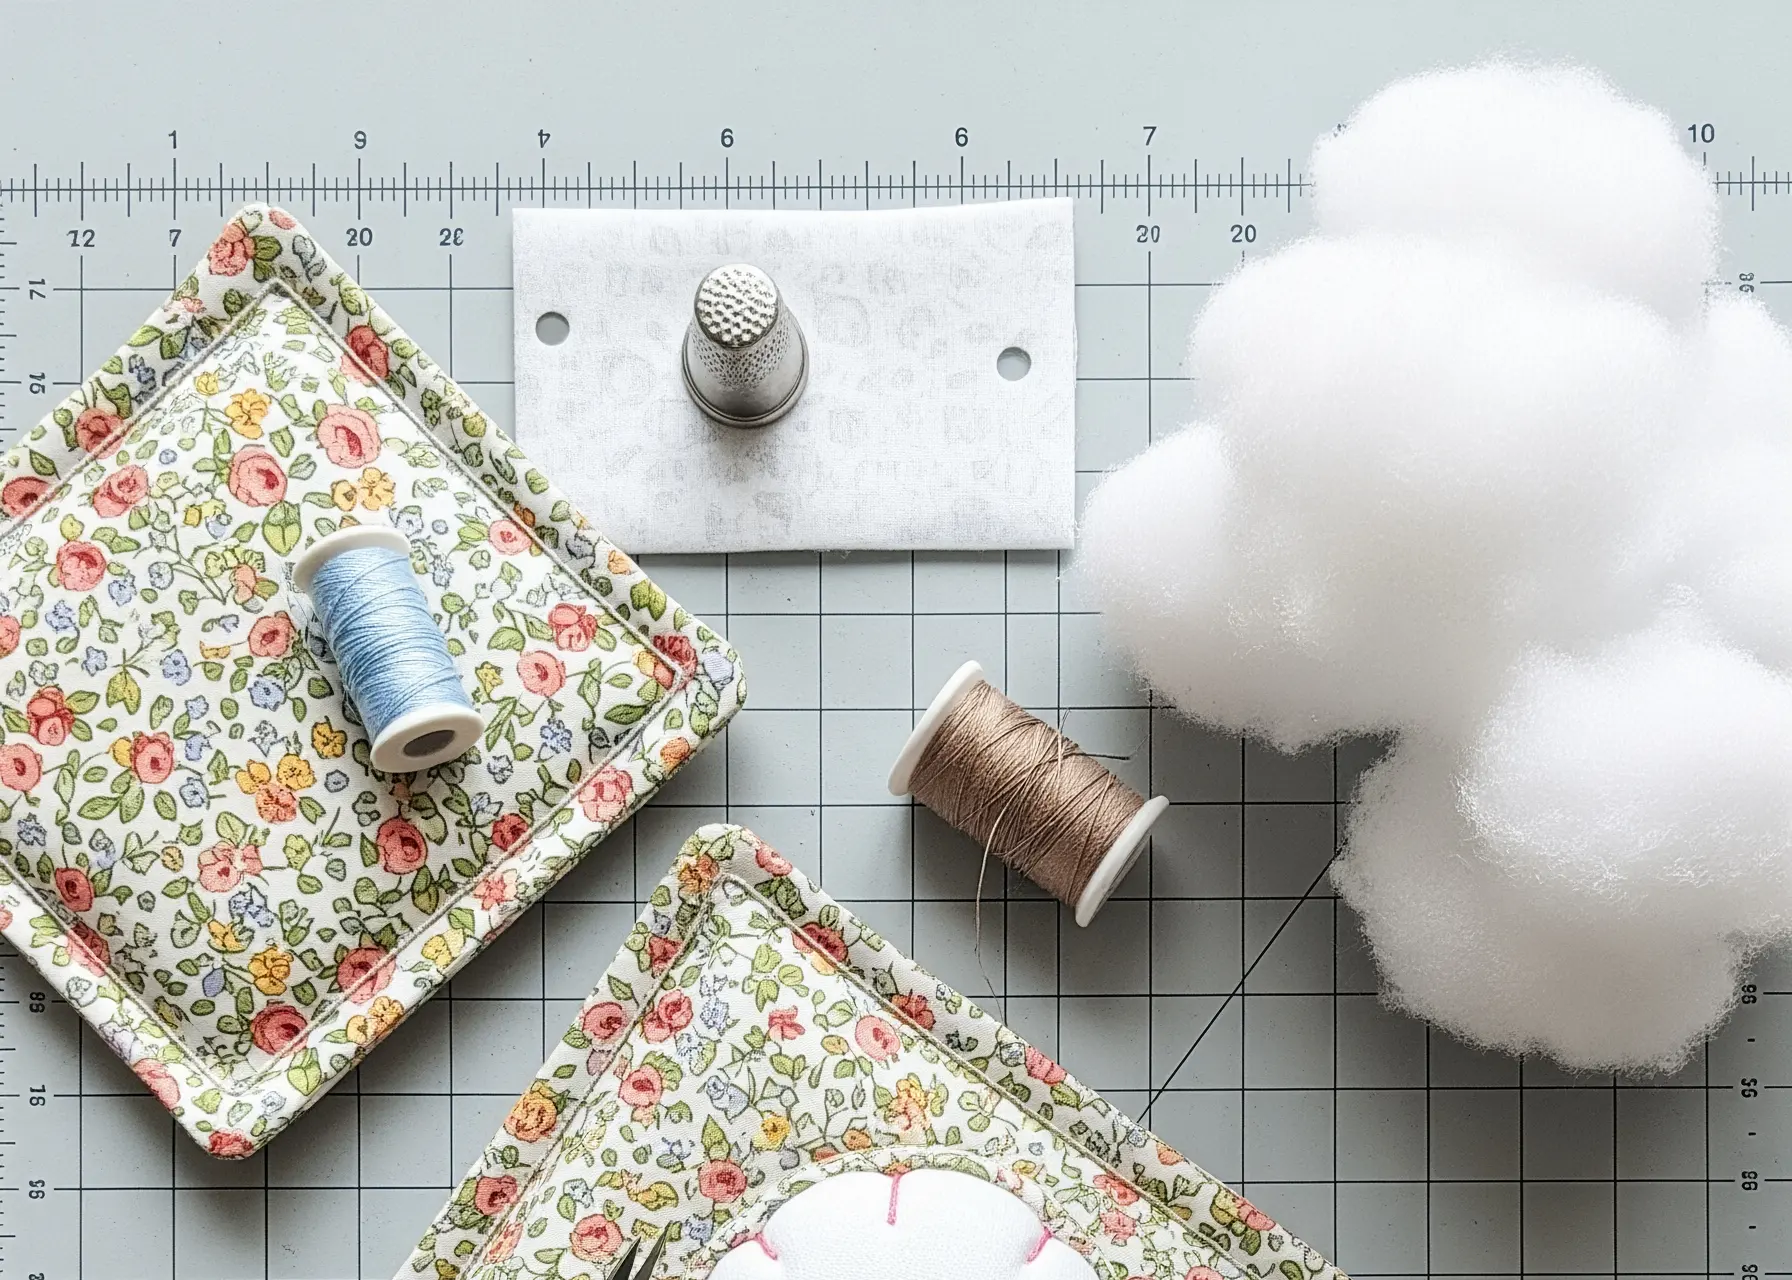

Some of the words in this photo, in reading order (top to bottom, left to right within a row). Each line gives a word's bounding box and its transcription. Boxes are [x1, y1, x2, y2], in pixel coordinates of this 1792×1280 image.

[167, 129, 178, 150] 1
[720, 127, 735, 149] 6
[954, 126, 969, 148] 6
[1142, 125, 1158, 147] 7
[1687, 123, 1715, 144] 10
[1229, 223, 1257, 244] 20
